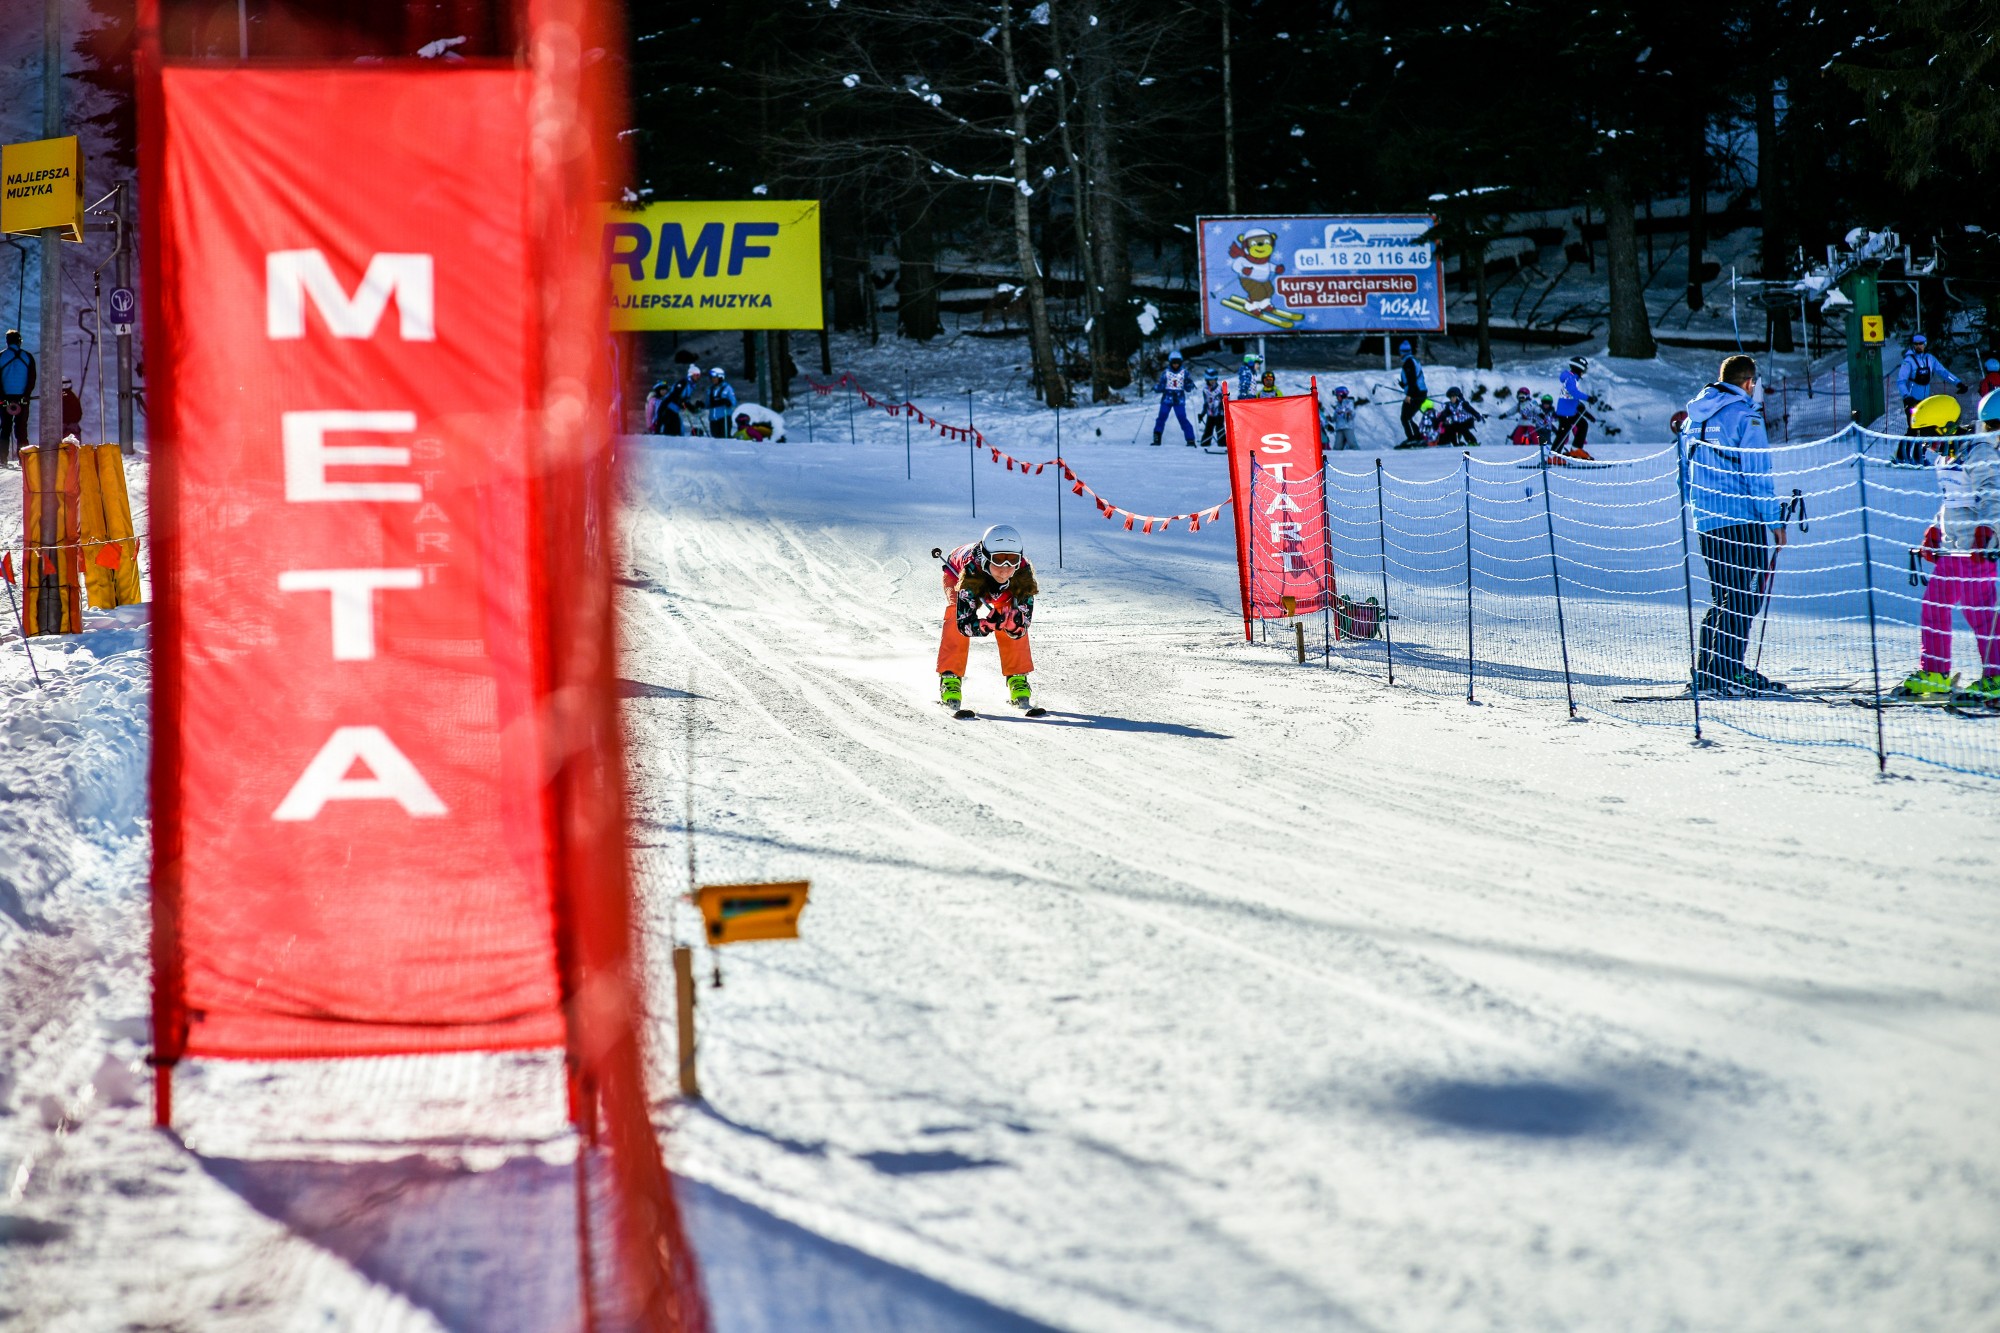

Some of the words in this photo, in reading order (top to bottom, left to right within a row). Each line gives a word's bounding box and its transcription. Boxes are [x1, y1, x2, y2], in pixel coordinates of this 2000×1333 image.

[7, 167, 69, 185] NAJLEPSZA
[7, 183, 52, 199] MUZYKA
[602, 222, 780, 281] RMF
[1300, 253, 1324, 266] tel.
[1330, 252, 1348, 265] 18
[1353, 252, 1371, 265] 20
[1378, 252, 1403, 264] 116
[1408, 251, 1427, 264] 46
[1281, 279, 1324, 293] kursy
[1328, 277, 1413, 290] narciarskie
[611, 294, 694, 308] AJLEPSZA
[700, 294, 772, 308] MUZYKA
[1289, 292, 1314, 305] dla
[1317, 291, 1362, 304] dzieci
[1260, 433, 1304, 572] START
[265, 247, 450, 822] META
